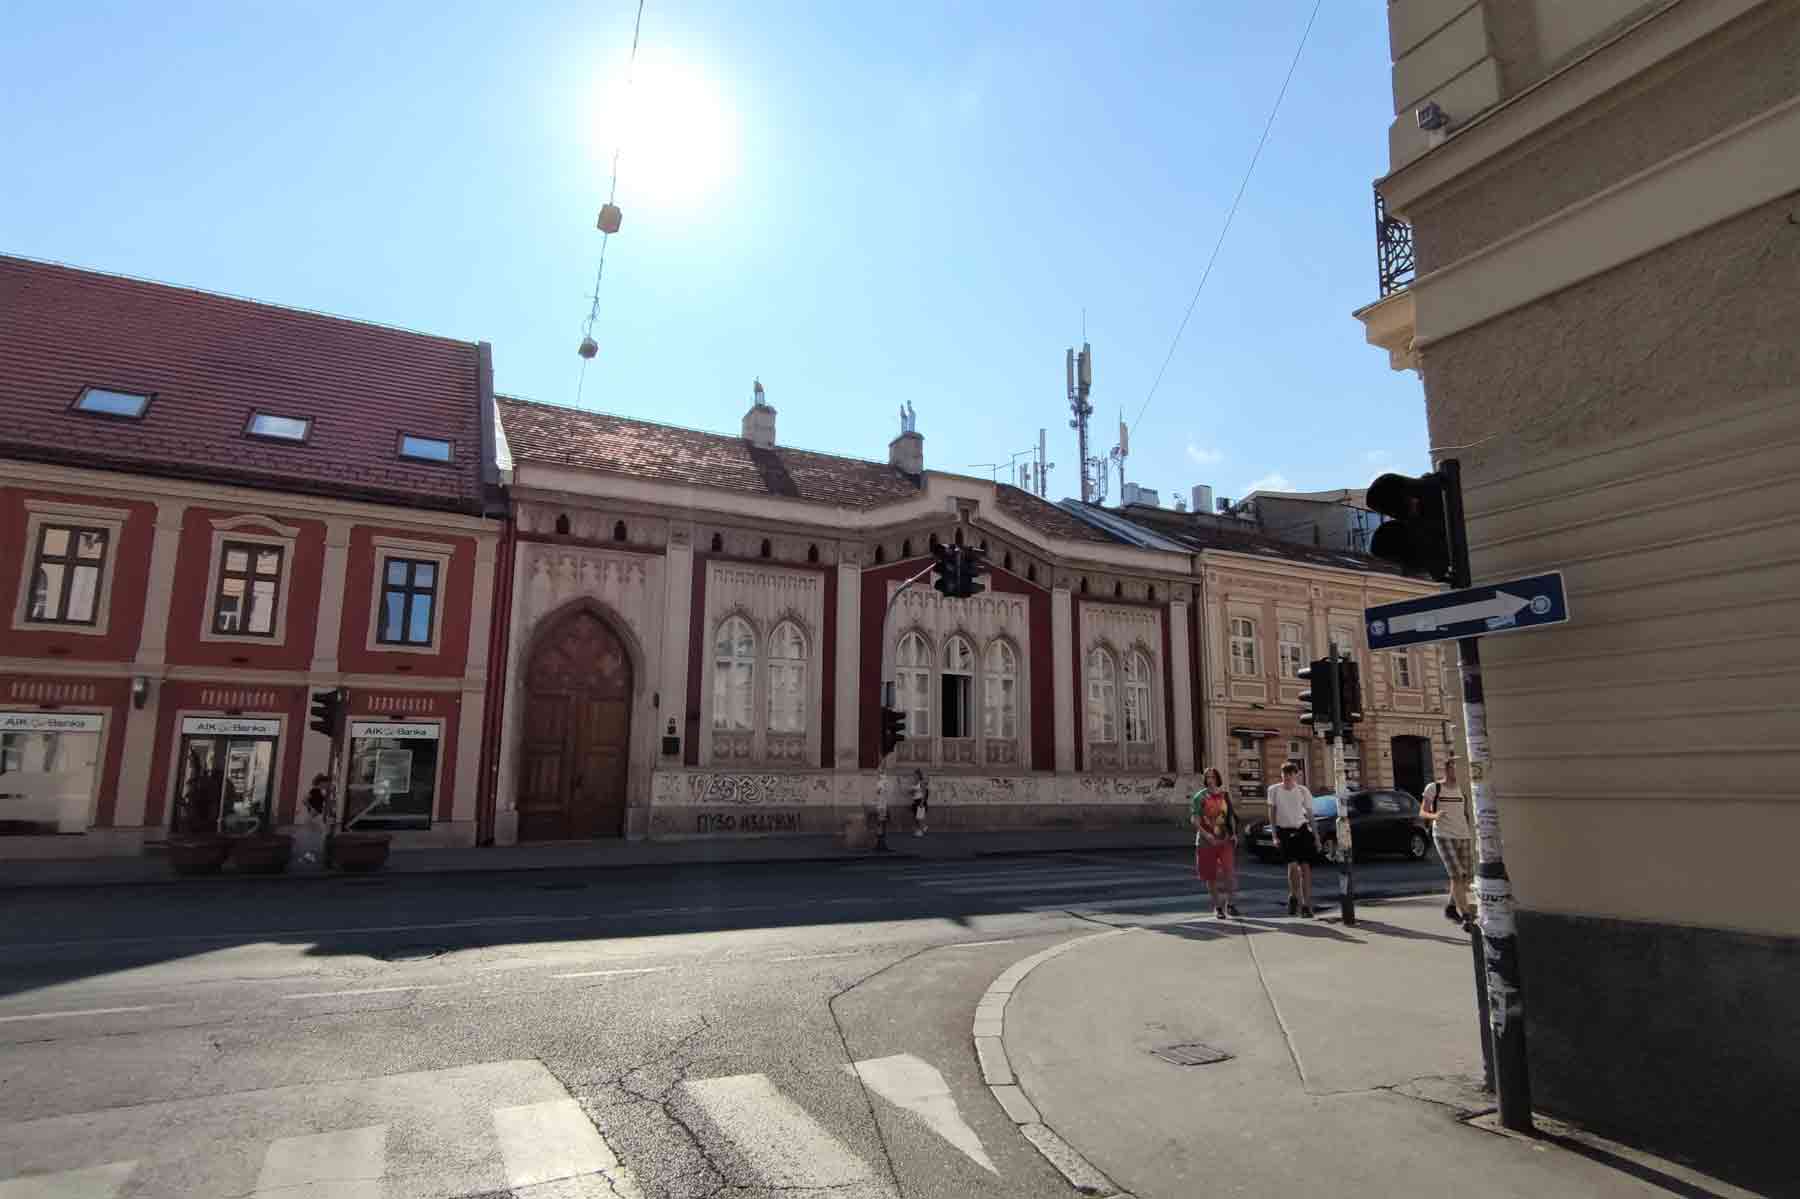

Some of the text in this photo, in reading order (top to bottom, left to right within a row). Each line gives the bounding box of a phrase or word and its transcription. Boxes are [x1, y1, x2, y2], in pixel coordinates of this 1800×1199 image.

[47, 718, 86, 729] Banka
[197, 722, 267, 733] AIK Banka
[365, 727, 427, 737] AIK Banka
